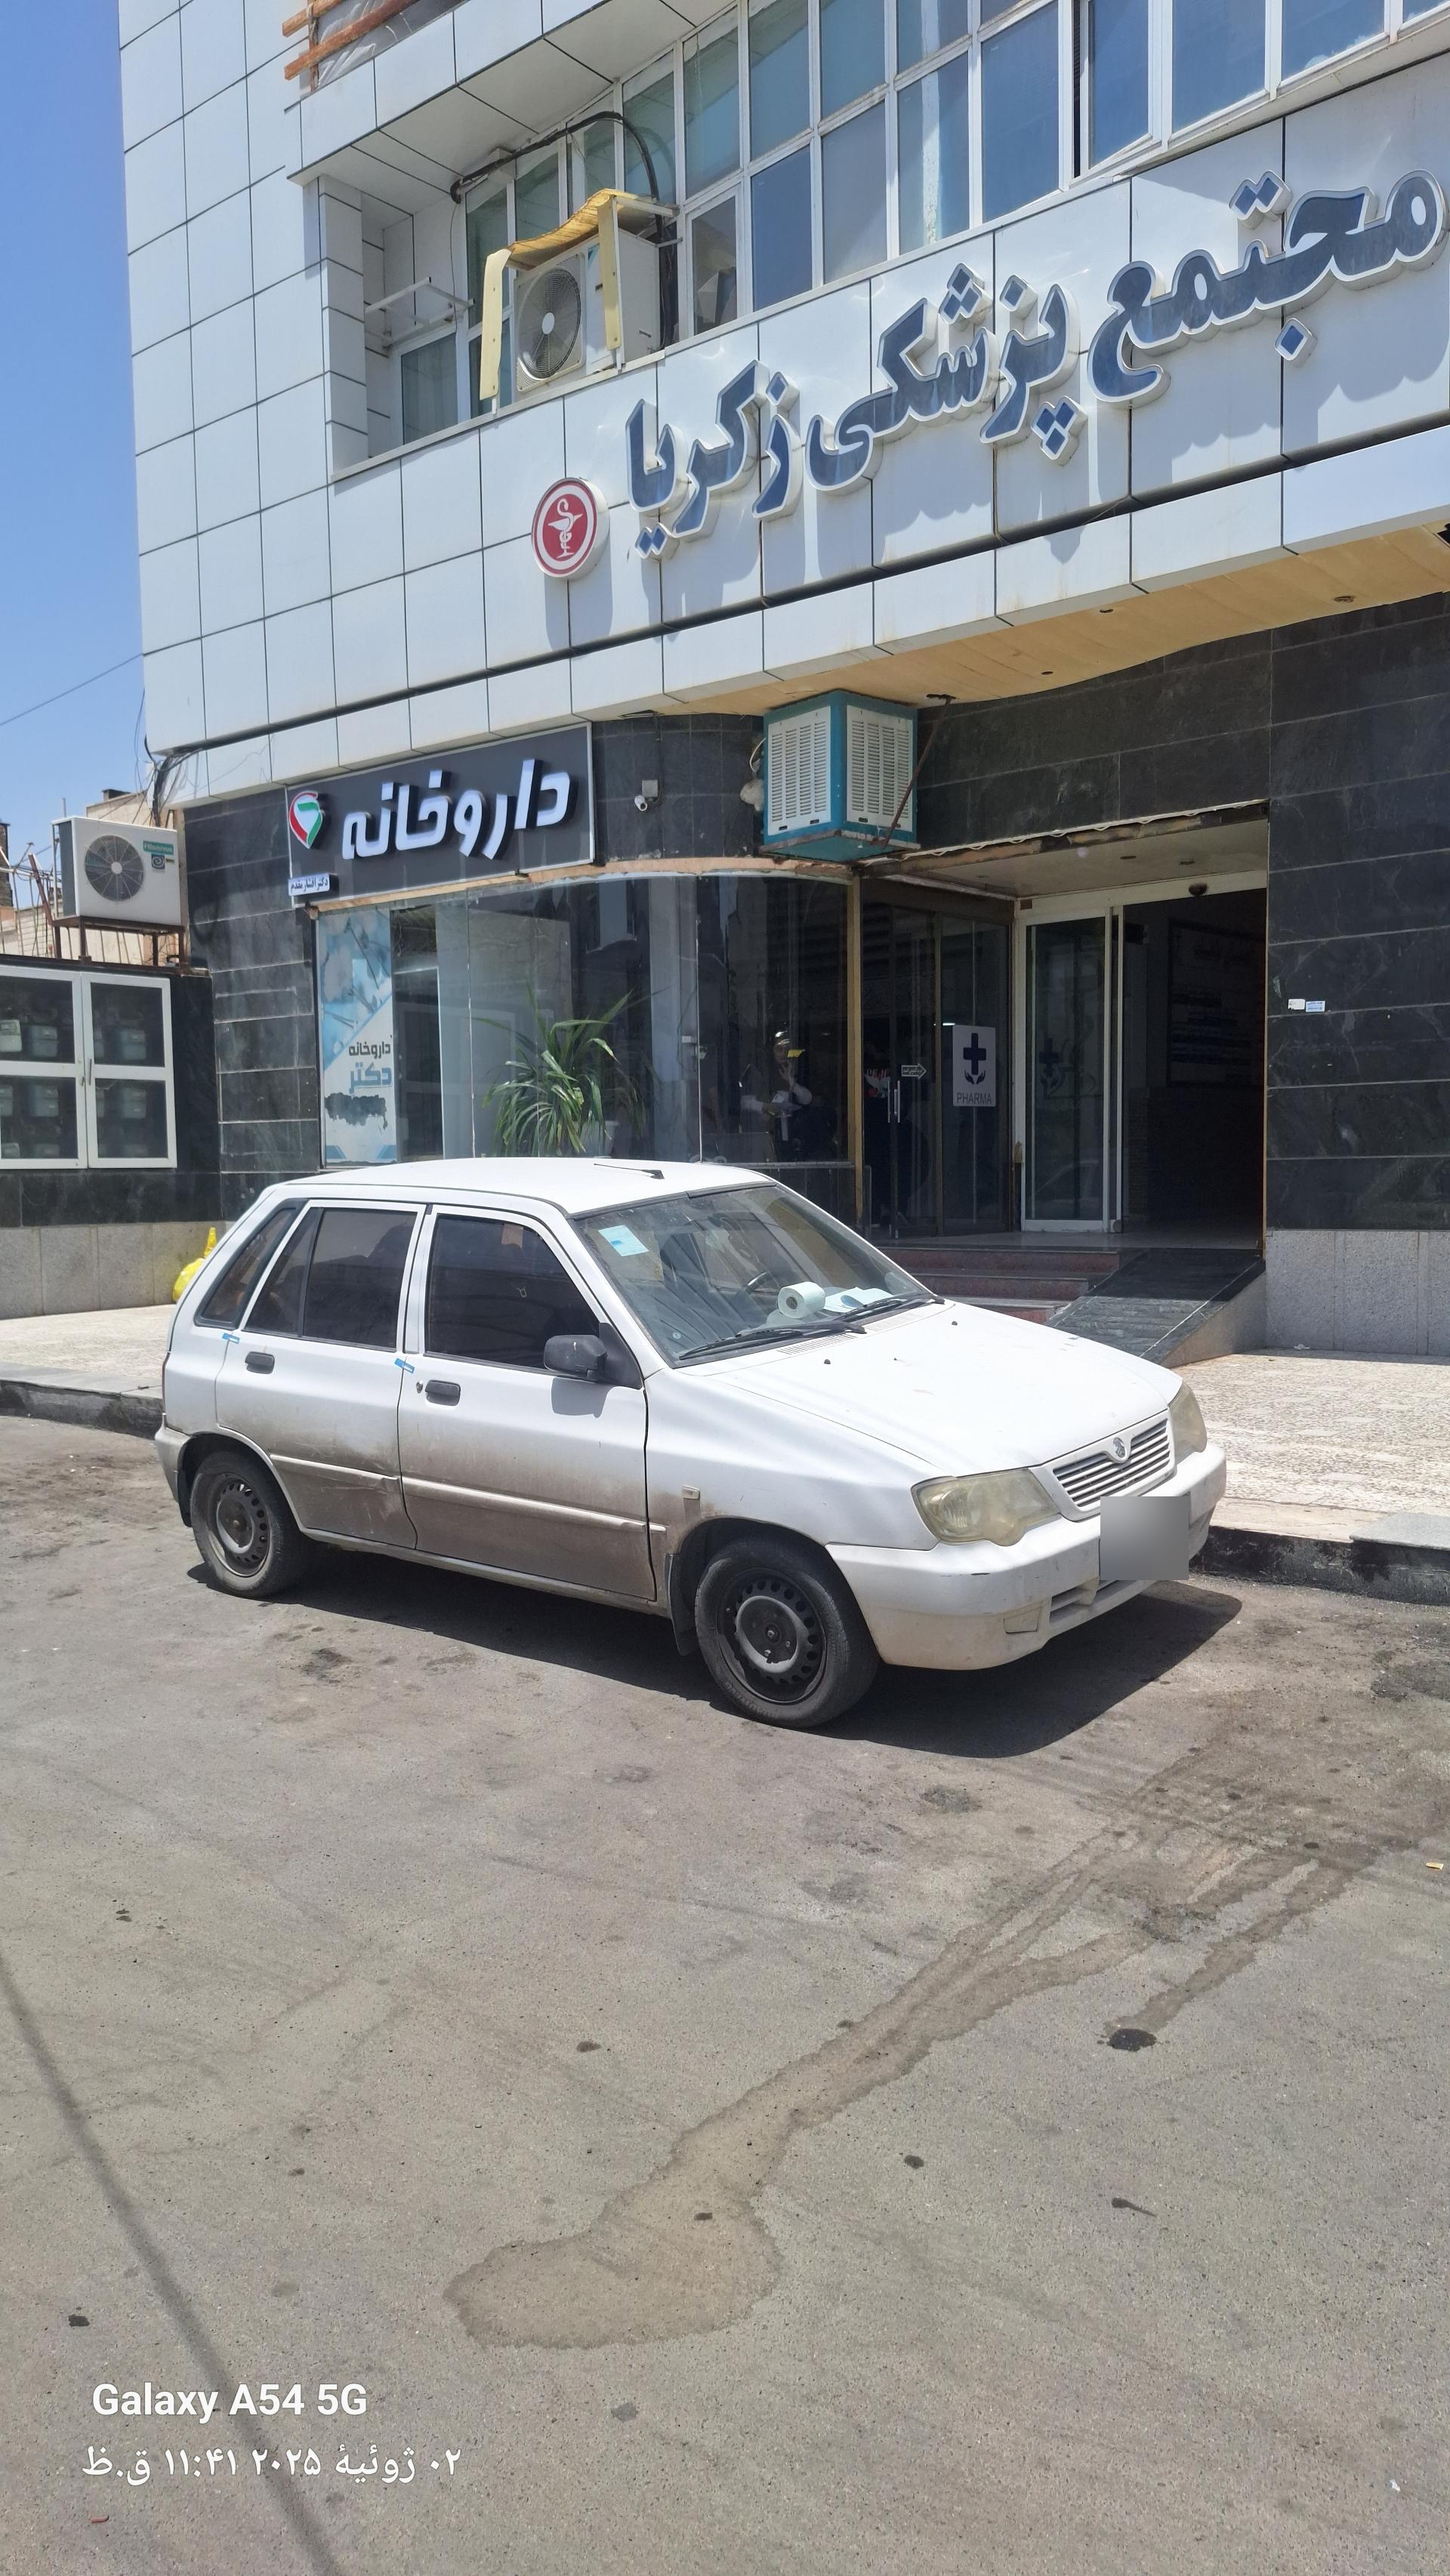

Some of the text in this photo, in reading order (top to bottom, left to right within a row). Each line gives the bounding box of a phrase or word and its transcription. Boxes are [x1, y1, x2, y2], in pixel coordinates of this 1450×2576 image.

[625, 168, 1448, 561] مجتمع پزشکی زکریا
[341, 758, 574, 861] داروخانه
[348, 1040, 391, 1060] داروخانه
[349, 1062, 393, 1095] دکتر
[956, 1092, 992, 1105] PHARMA
